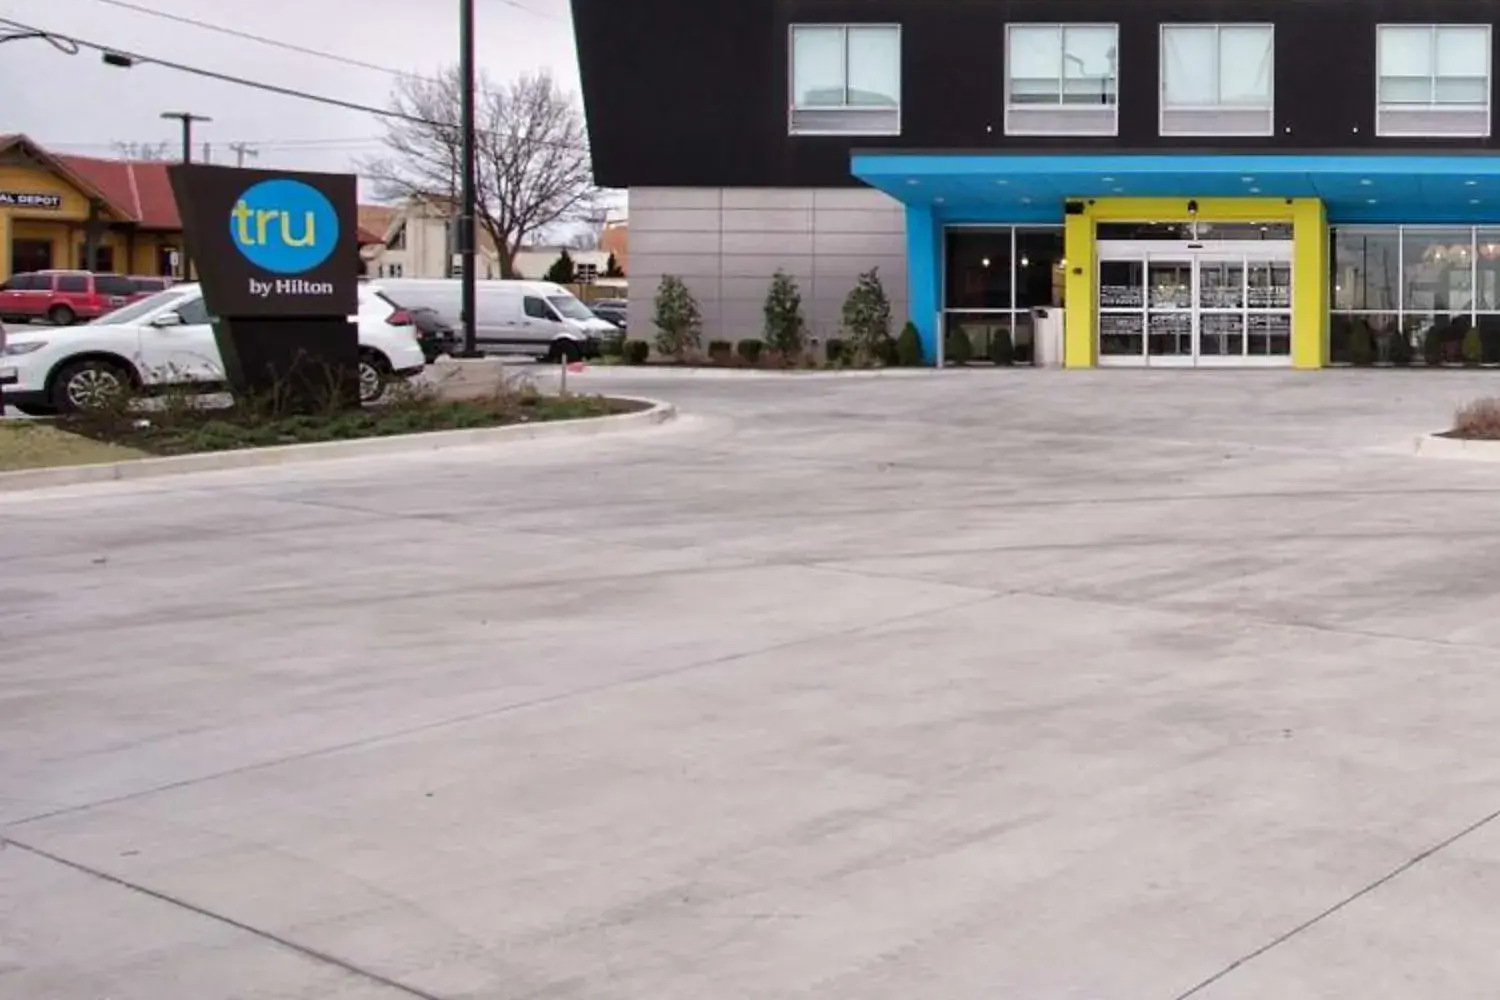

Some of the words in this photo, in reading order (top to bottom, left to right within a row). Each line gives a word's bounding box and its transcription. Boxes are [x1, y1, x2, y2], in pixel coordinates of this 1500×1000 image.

[17, 195, 58, 206] DEPOT
[231, 199, 315, 247] tru
[249, 278, 273, 297] by
[276, 279, 333, 295] Hilton
